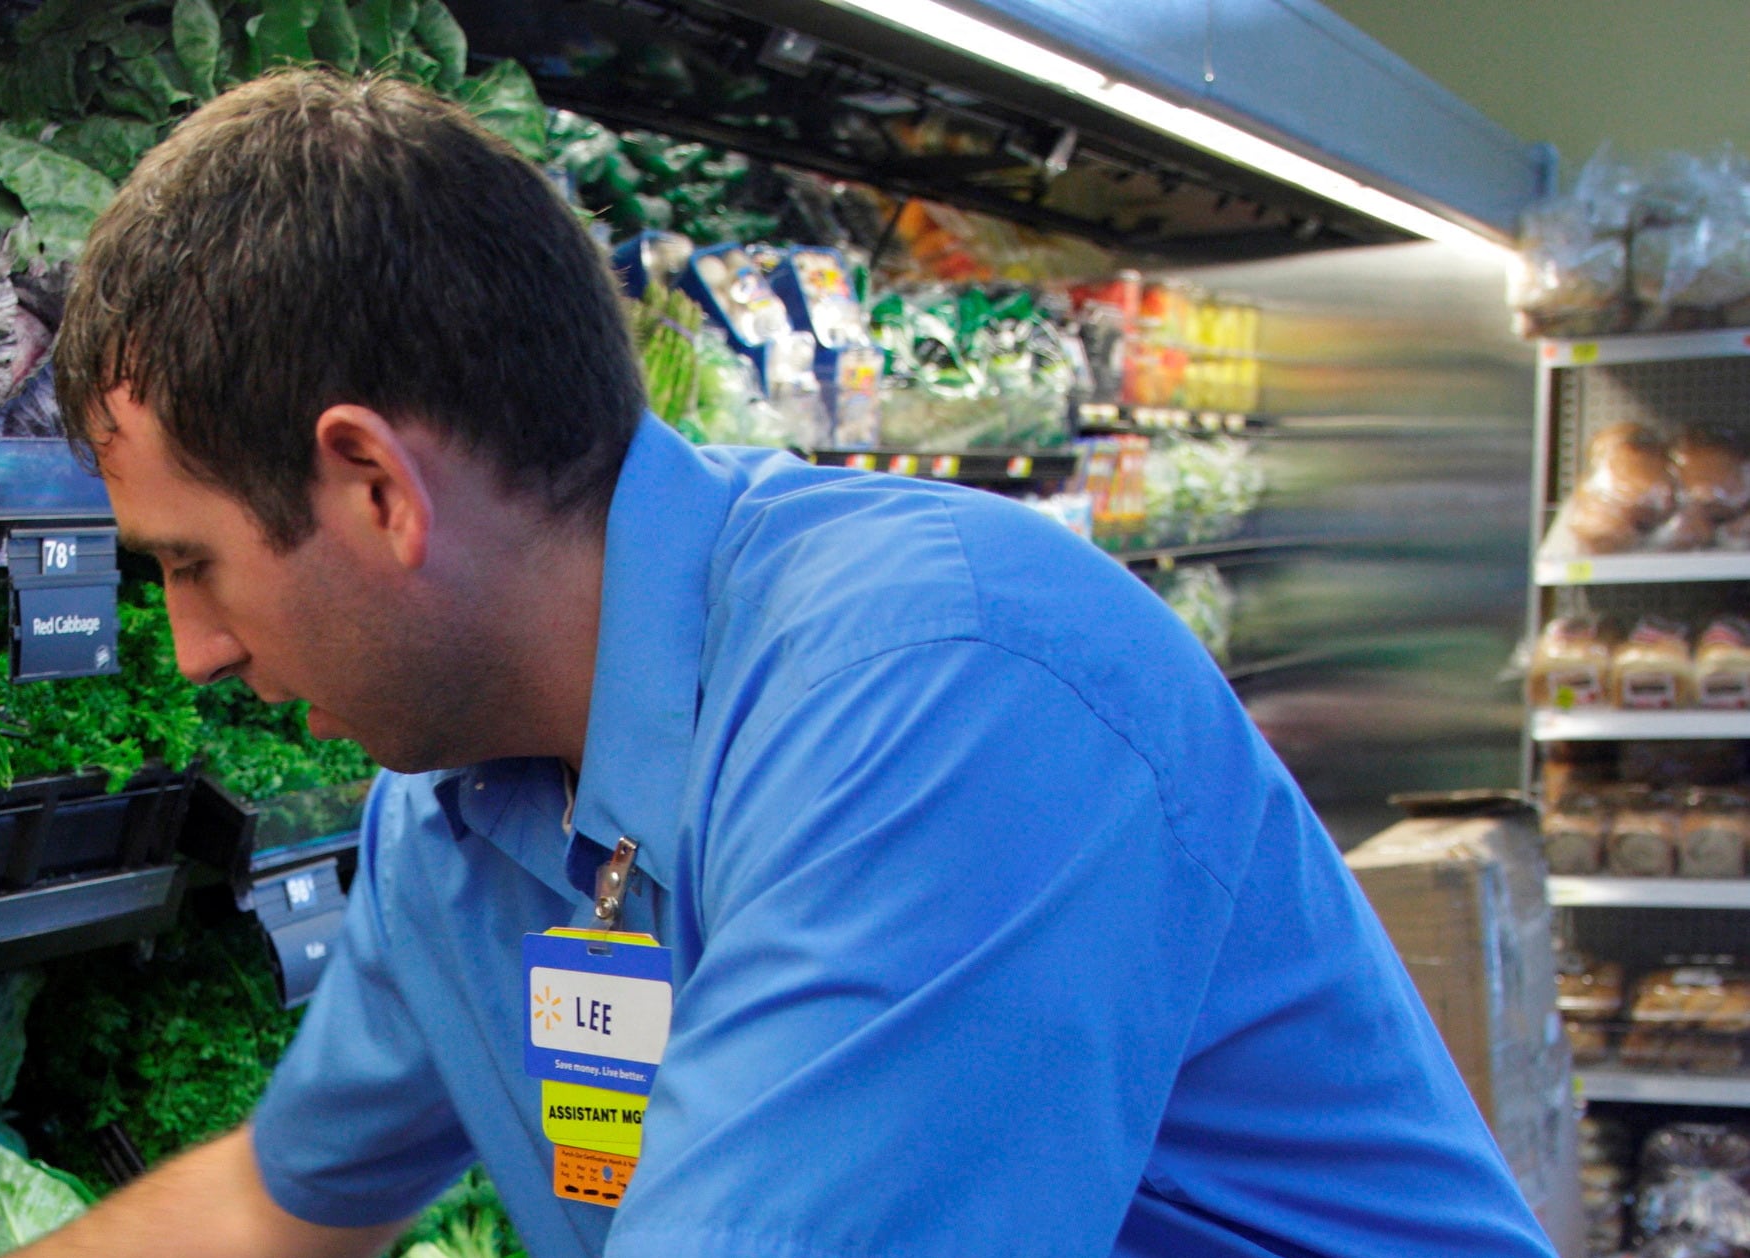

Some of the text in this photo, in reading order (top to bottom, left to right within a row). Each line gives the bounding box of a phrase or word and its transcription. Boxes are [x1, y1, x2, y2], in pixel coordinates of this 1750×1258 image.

[33, 615, 101, 636] Red Cabbage
[576, 996, 612, 1035] LEE
[555, 1058, 647, 1082] Save money. Live better.
[549, 1105, 645, 1124] ASSISTANT MG
